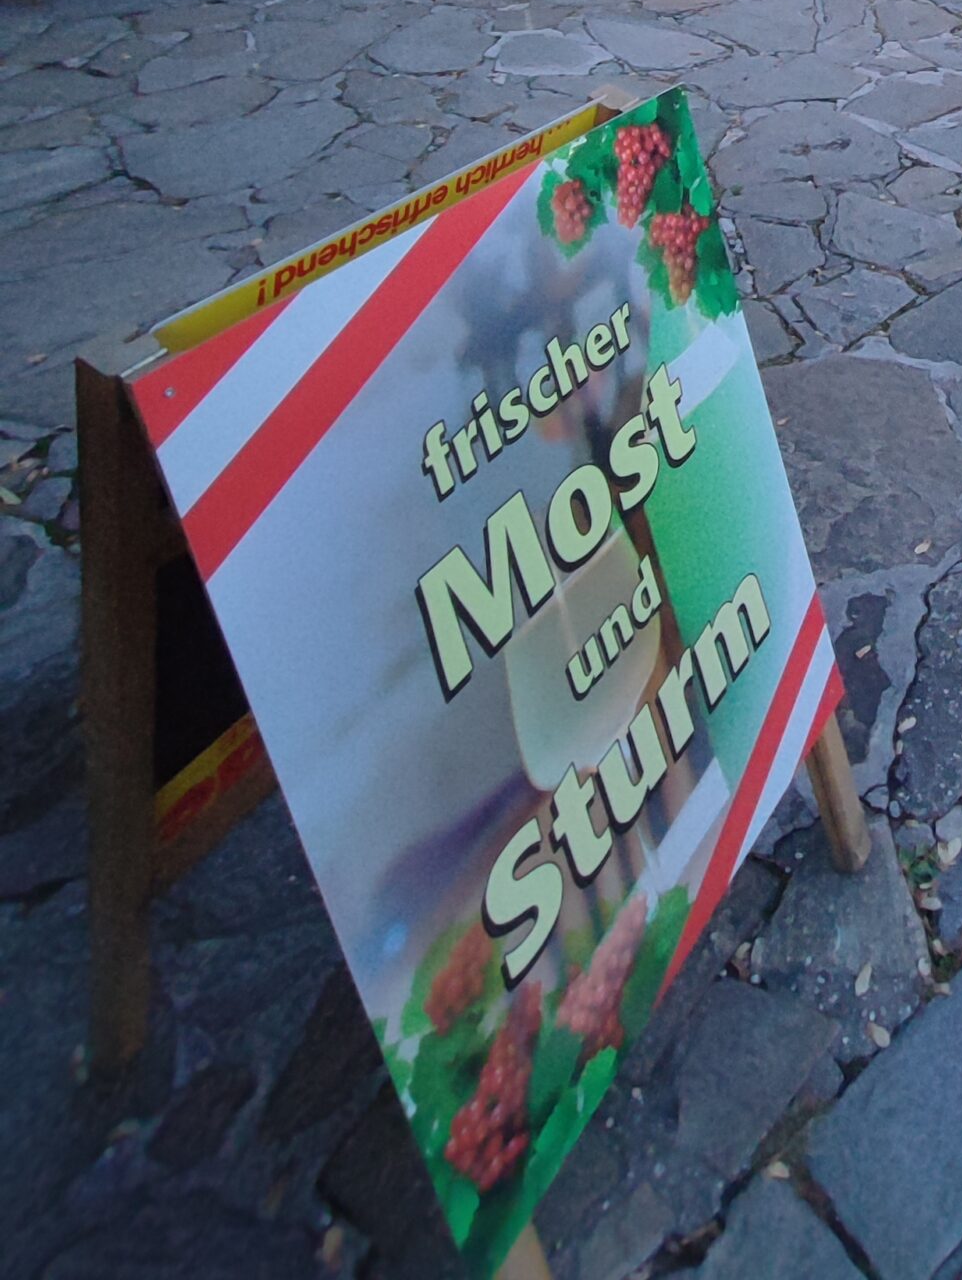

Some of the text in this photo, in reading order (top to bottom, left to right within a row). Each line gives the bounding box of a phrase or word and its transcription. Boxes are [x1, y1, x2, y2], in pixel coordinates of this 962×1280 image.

[415, 363, 698, 702] Most
[422, 300, 631, 502] frischer
[566, 555, 663, 701] und
[481, 572, 772, 990] Sturm
